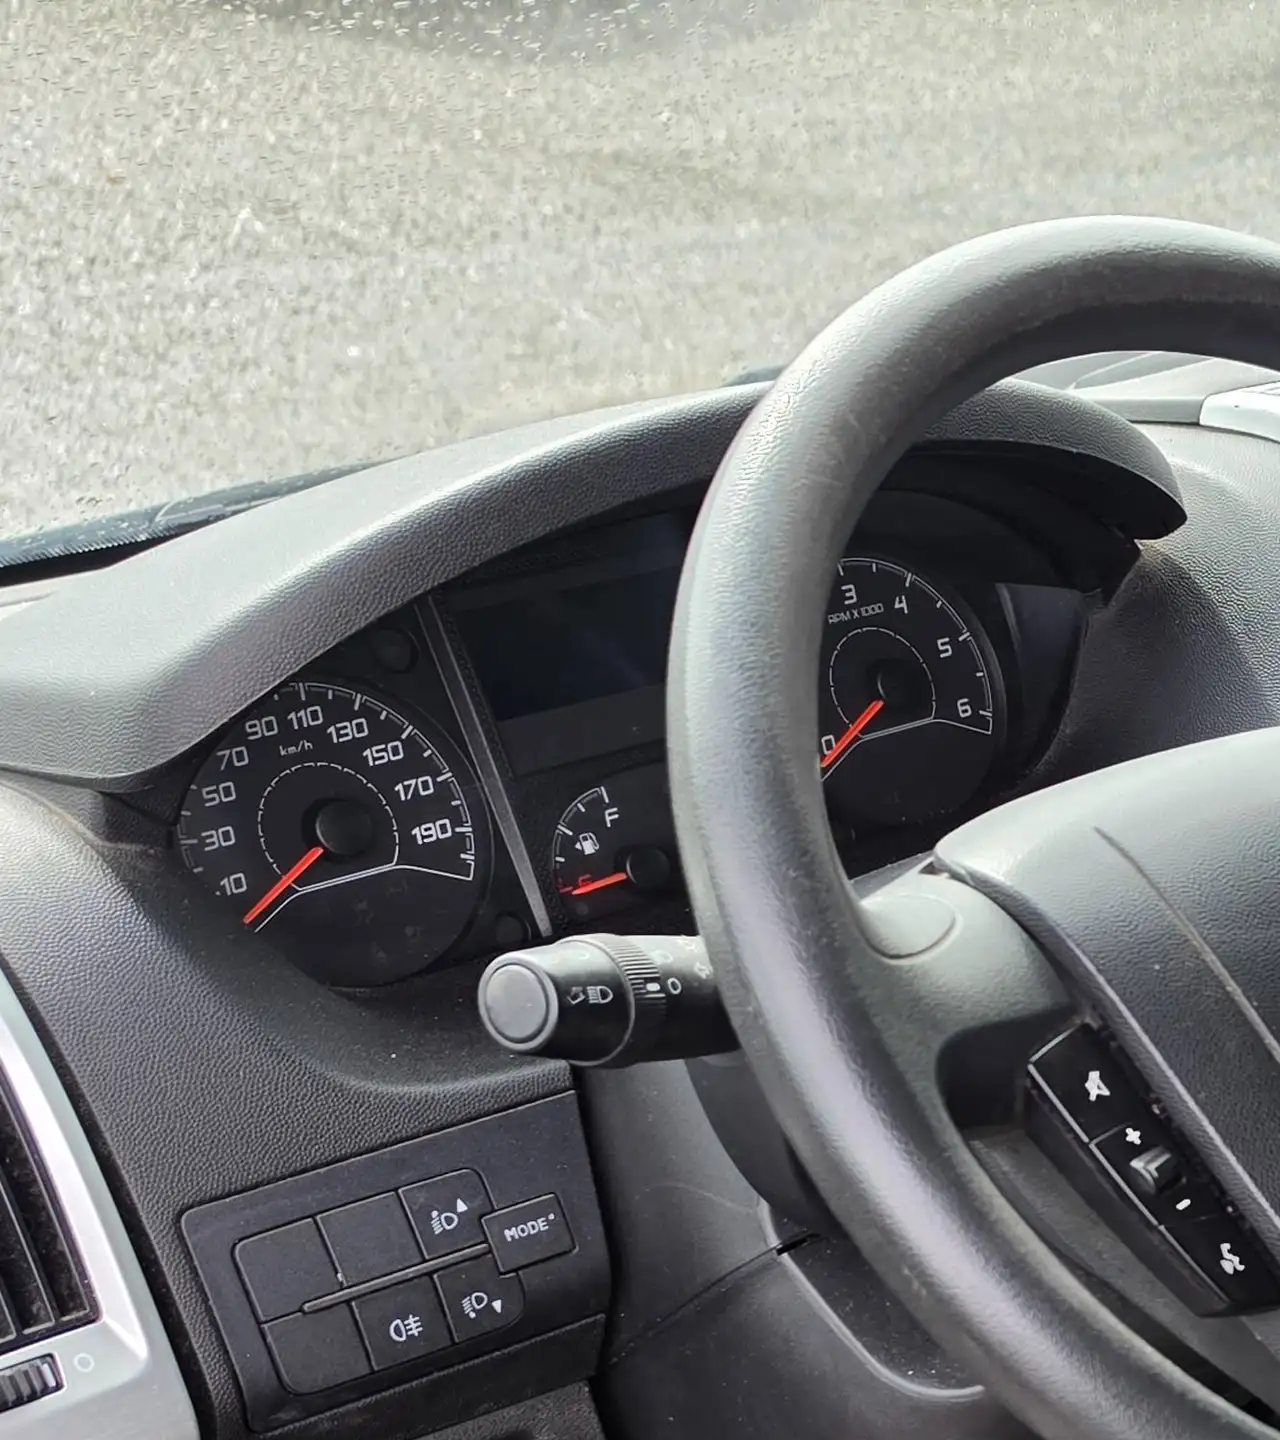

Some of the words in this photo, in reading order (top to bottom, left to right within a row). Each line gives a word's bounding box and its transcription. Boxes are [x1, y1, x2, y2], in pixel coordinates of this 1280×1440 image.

[841, 584, 857, 605] 3
[894, 595, 908, 614] 4
[937, 637, 953, 659] 5
[287, 705, 323, 730] 110
[956, 698, 972, 718] 6
[245, 716, 278, 740] 90
[327, 718, 369, 743] 130
[216, 746, 249, 771] 70
[279, 739, 314, 756] km/h
[363, 741, 404, 766] 150
[202, 781, 236, 807] 50
[394, 776, 434, 801] 170
[604, 807, 619, 828] F
[201, 826, 236, 851] 30
[411, 819, 452, 845] 190
[220, 873, 248, 895] 10
[504, 1217, 549, 1242] MODE
